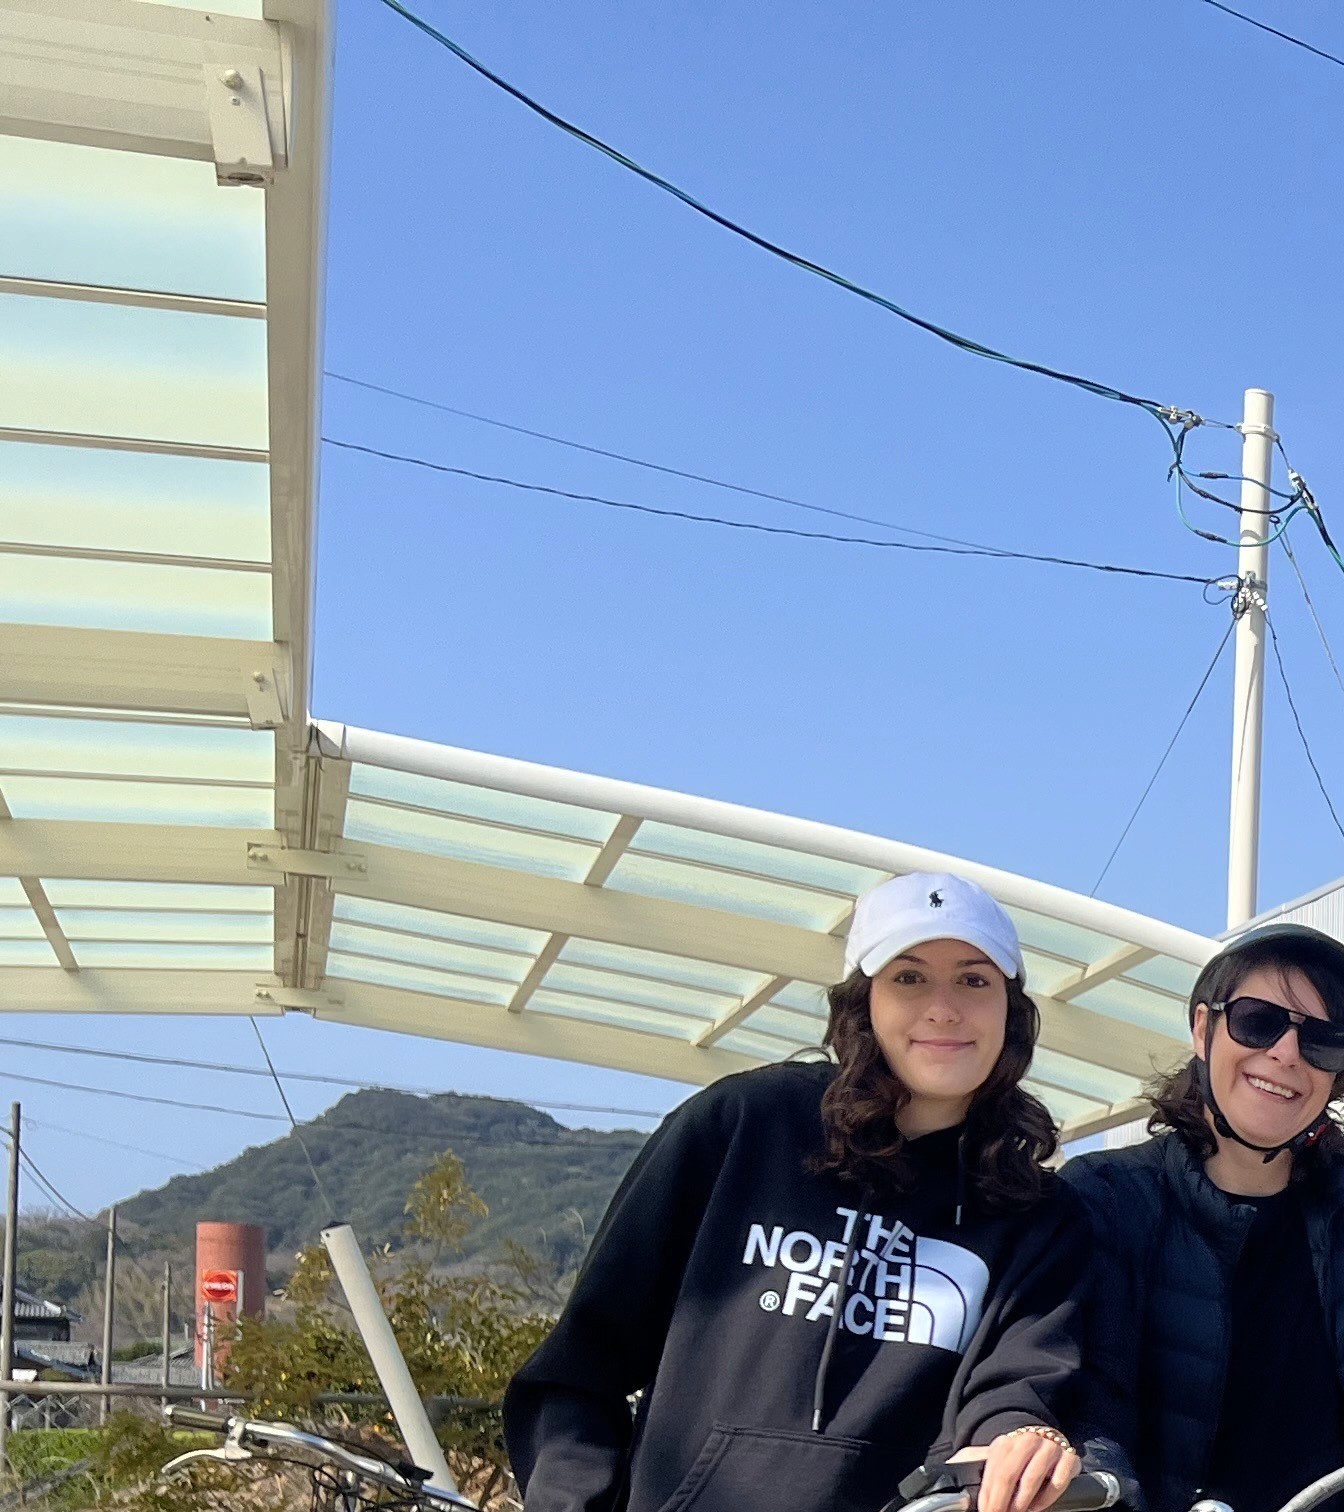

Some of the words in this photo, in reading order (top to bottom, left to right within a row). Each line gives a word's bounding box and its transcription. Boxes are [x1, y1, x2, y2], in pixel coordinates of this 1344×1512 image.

[742, 1223, 912, 1300] NORTH
[836, 1206, 914, 1264] THE
[781, 1271, 909, 1342] FACE
